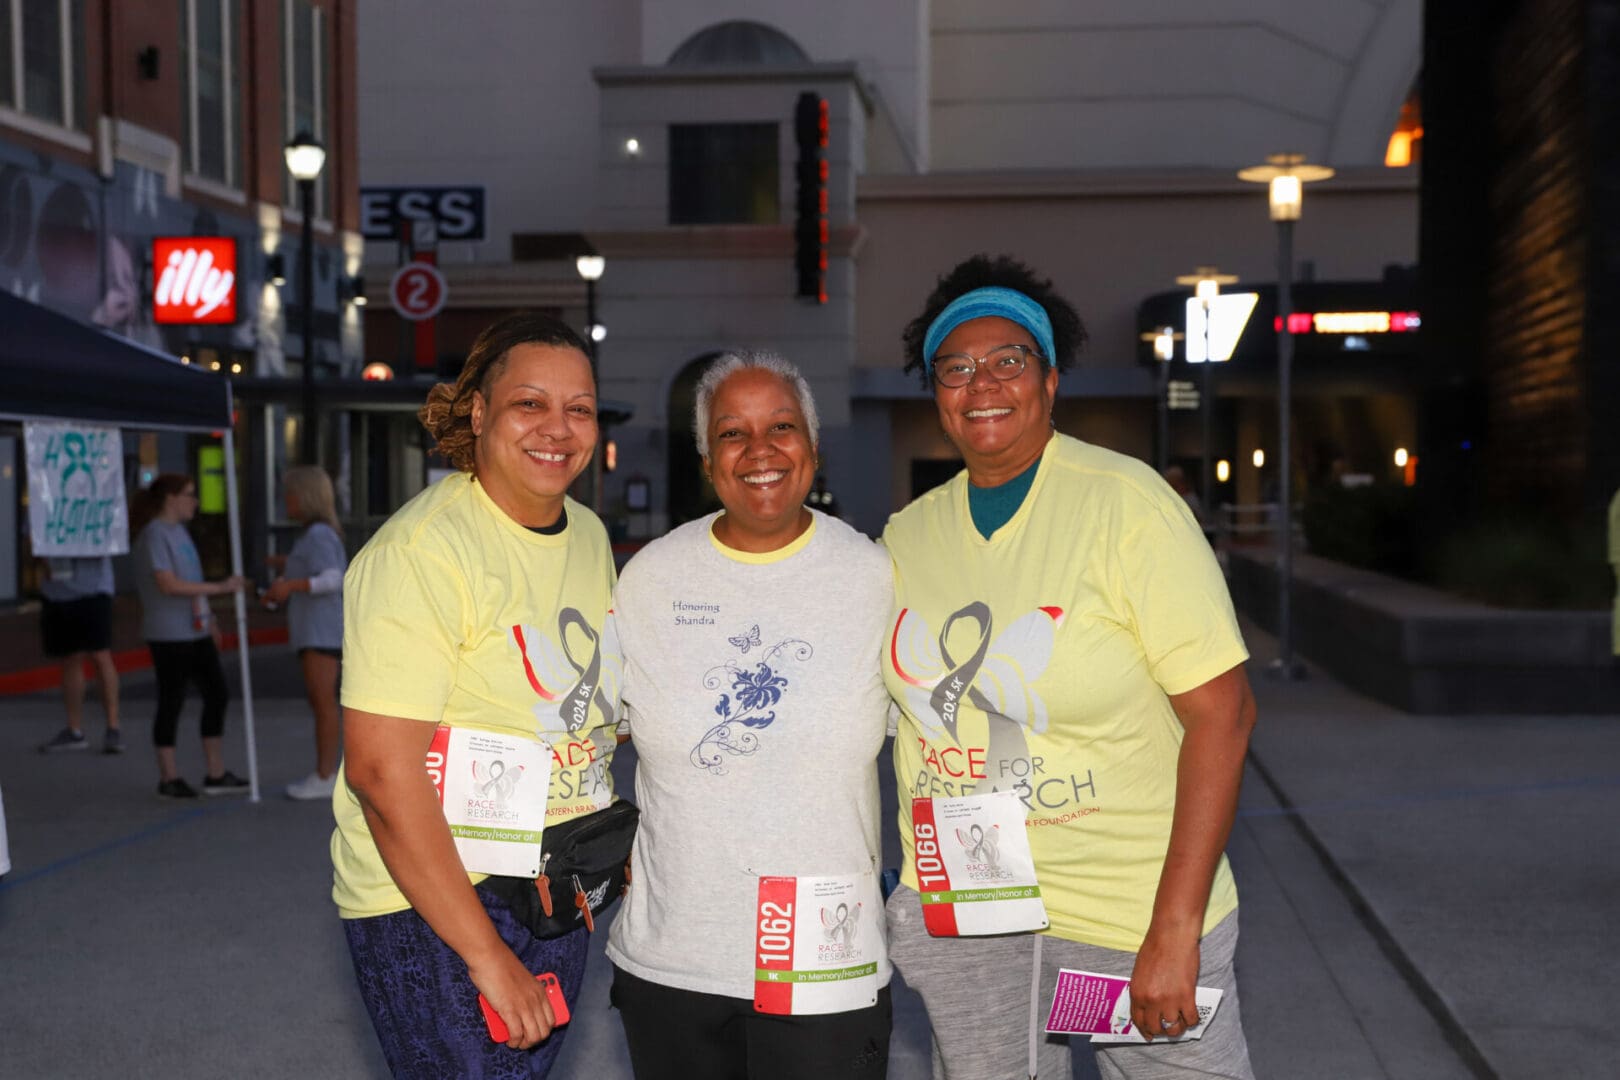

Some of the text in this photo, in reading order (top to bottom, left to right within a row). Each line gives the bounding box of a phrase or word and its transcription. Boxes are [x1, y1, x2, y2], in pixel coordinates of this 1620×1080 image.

[155, 248, 235, 319] illy
[408, 274, 429, 309] 2
[672, 600, 720, 613] Honoring
[674, 615, 715, 626] Shandra
[579, 681, 593, 698] 5K
[943, 676, 964, 723] 204 5K
[999, 756, 1046, 779] FOR
[467, 799, 495, 810] RACE
[575, 804, 598, 815] BRAIN
[467, 809, 519, 821] RESEARCH
[1033, 806, 1101, 827] FOUNDATION
[915, 823, 946, 887] 1066
[966, 863, 990, 872] RACE
[969, 871, 1014, 881] RESEARCH
[931, 894, 941, 902] 1K
[759, 902, 793, 964] 1062
[818, 944, 844, 953] RACE
[818, 949, 862, 962] RESEARCH
[768, 972, 779, 981] 1K
[798, 974, 807, 982] In
